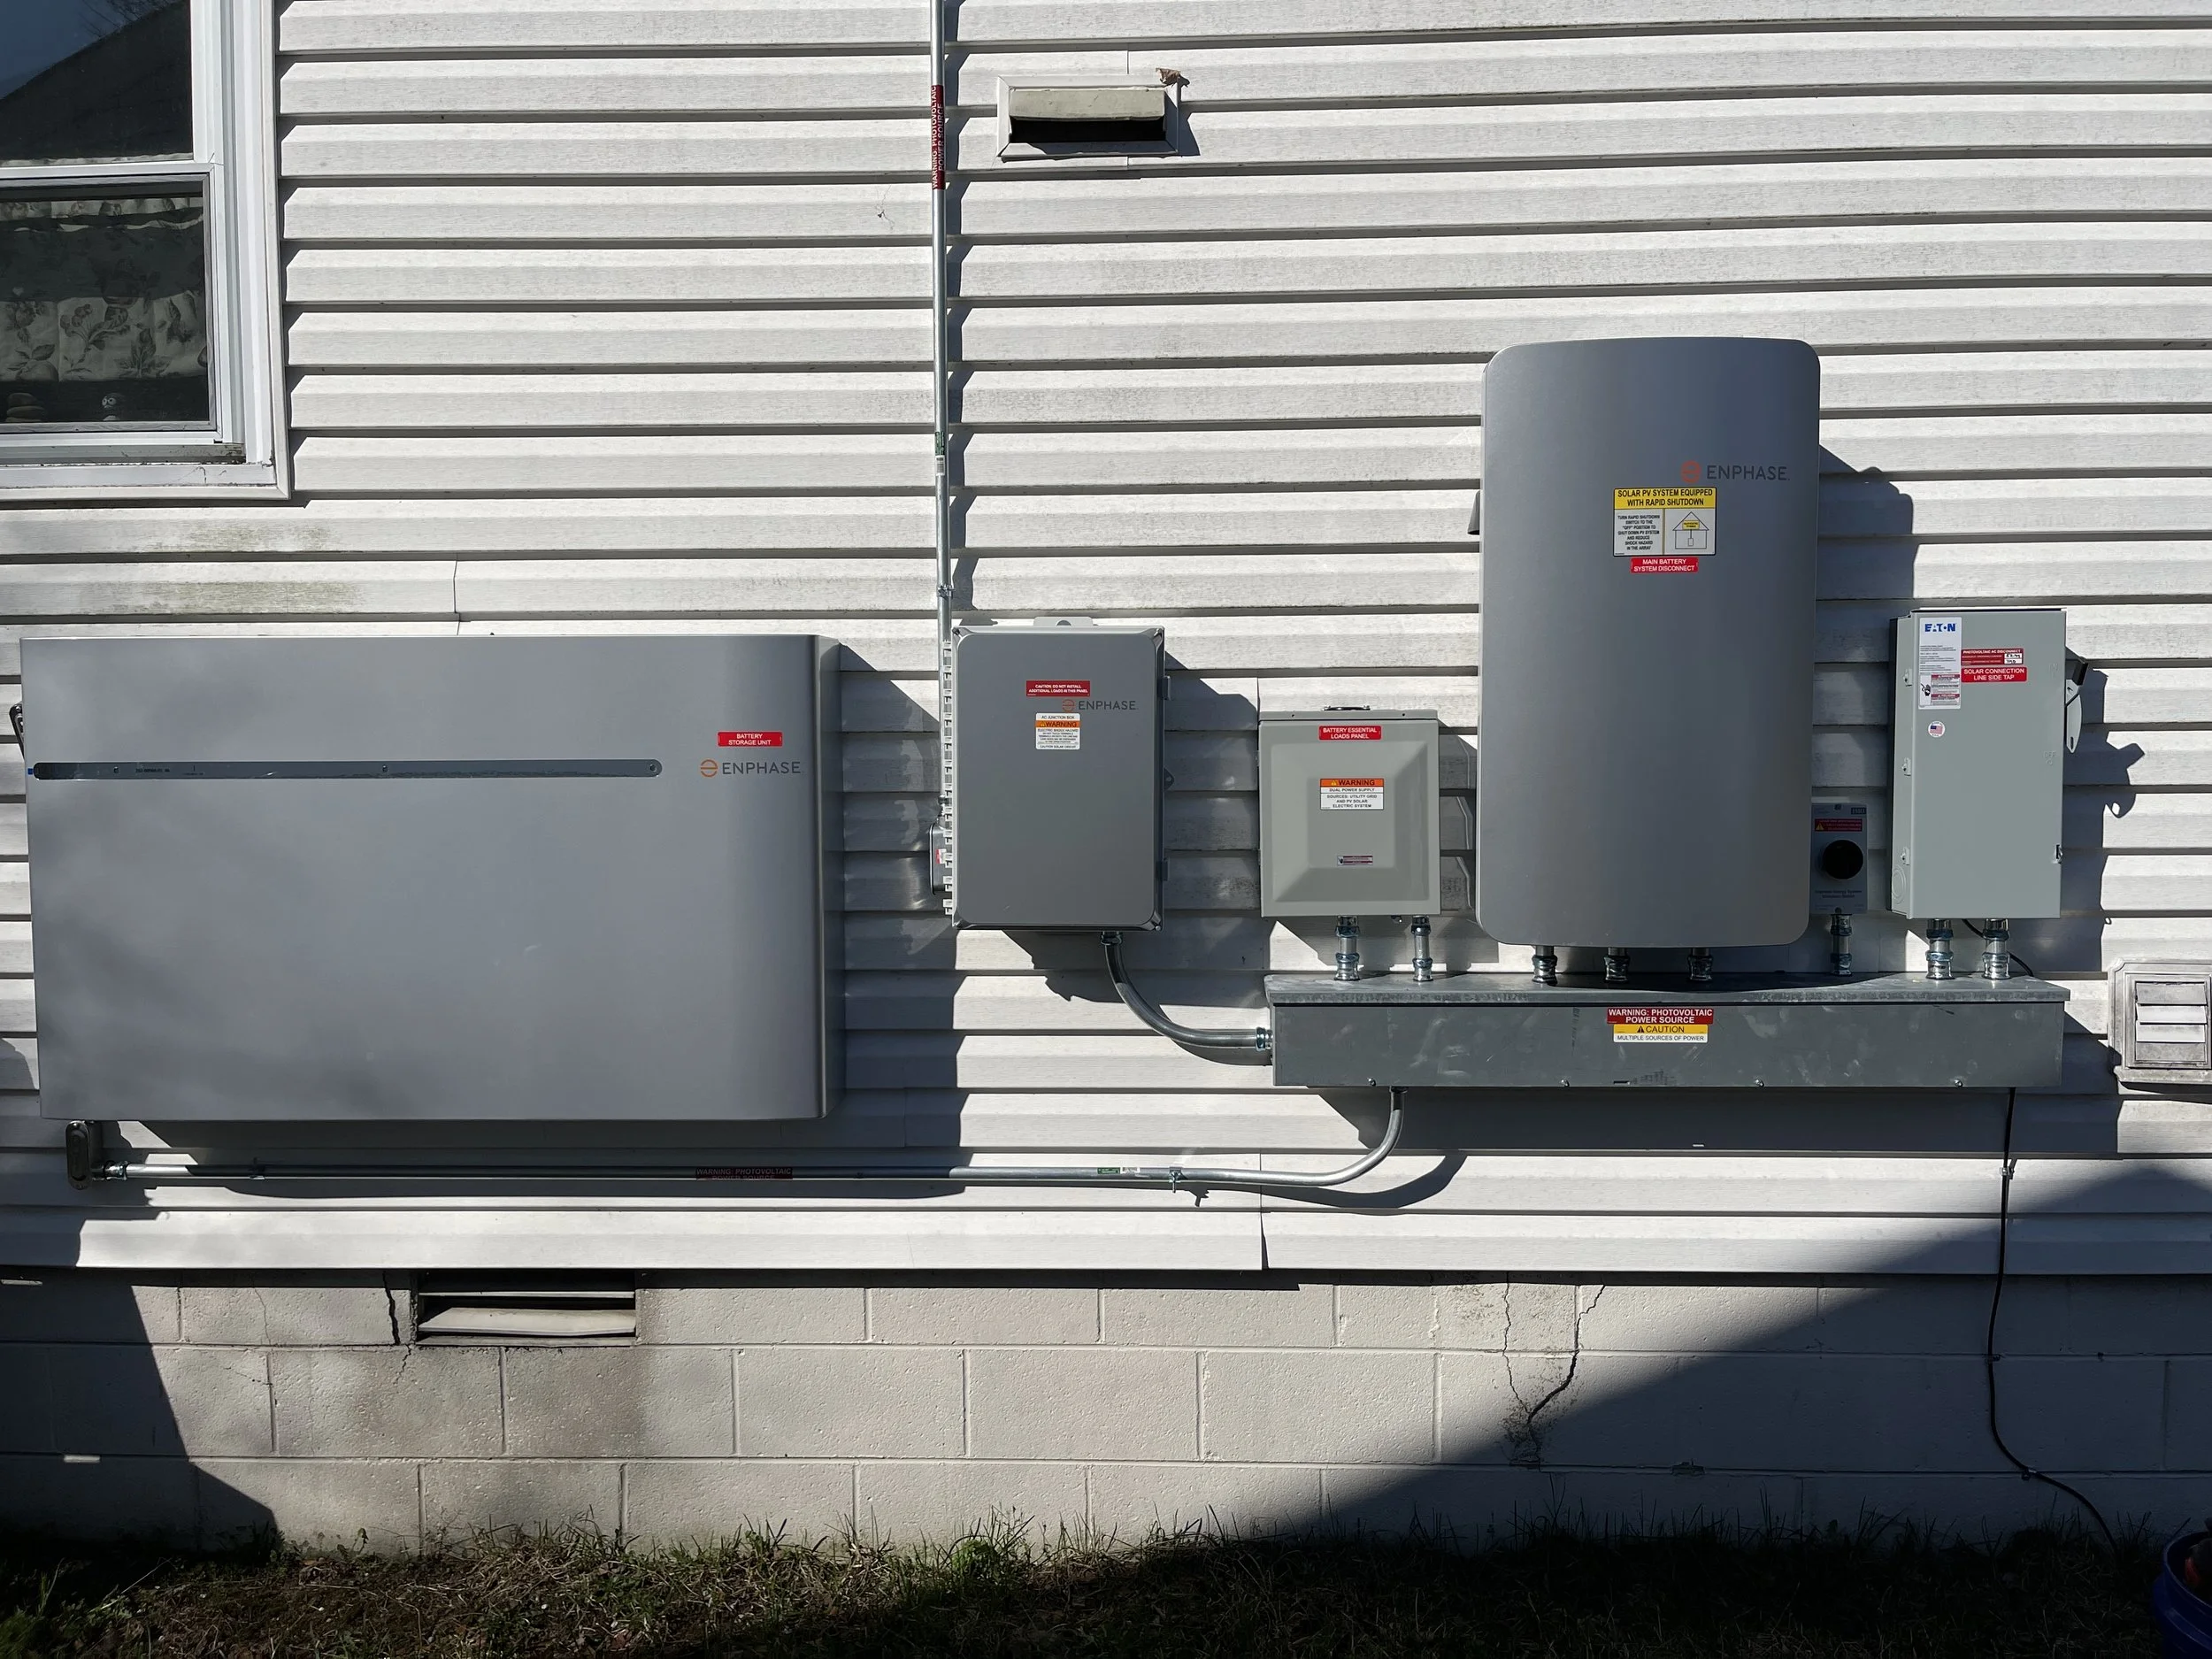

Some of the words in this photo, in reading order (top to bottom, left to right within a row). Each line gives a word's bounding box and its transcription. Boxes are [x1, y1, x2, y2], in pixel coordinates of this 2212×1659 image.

[1706, 465, 1787, 481] ENPHASE
[1924, 623, 1956, 633] EATON
[1079, 701, 1136, 710] ENPHASE
[722, 761, 801, 774] ENPHASE
